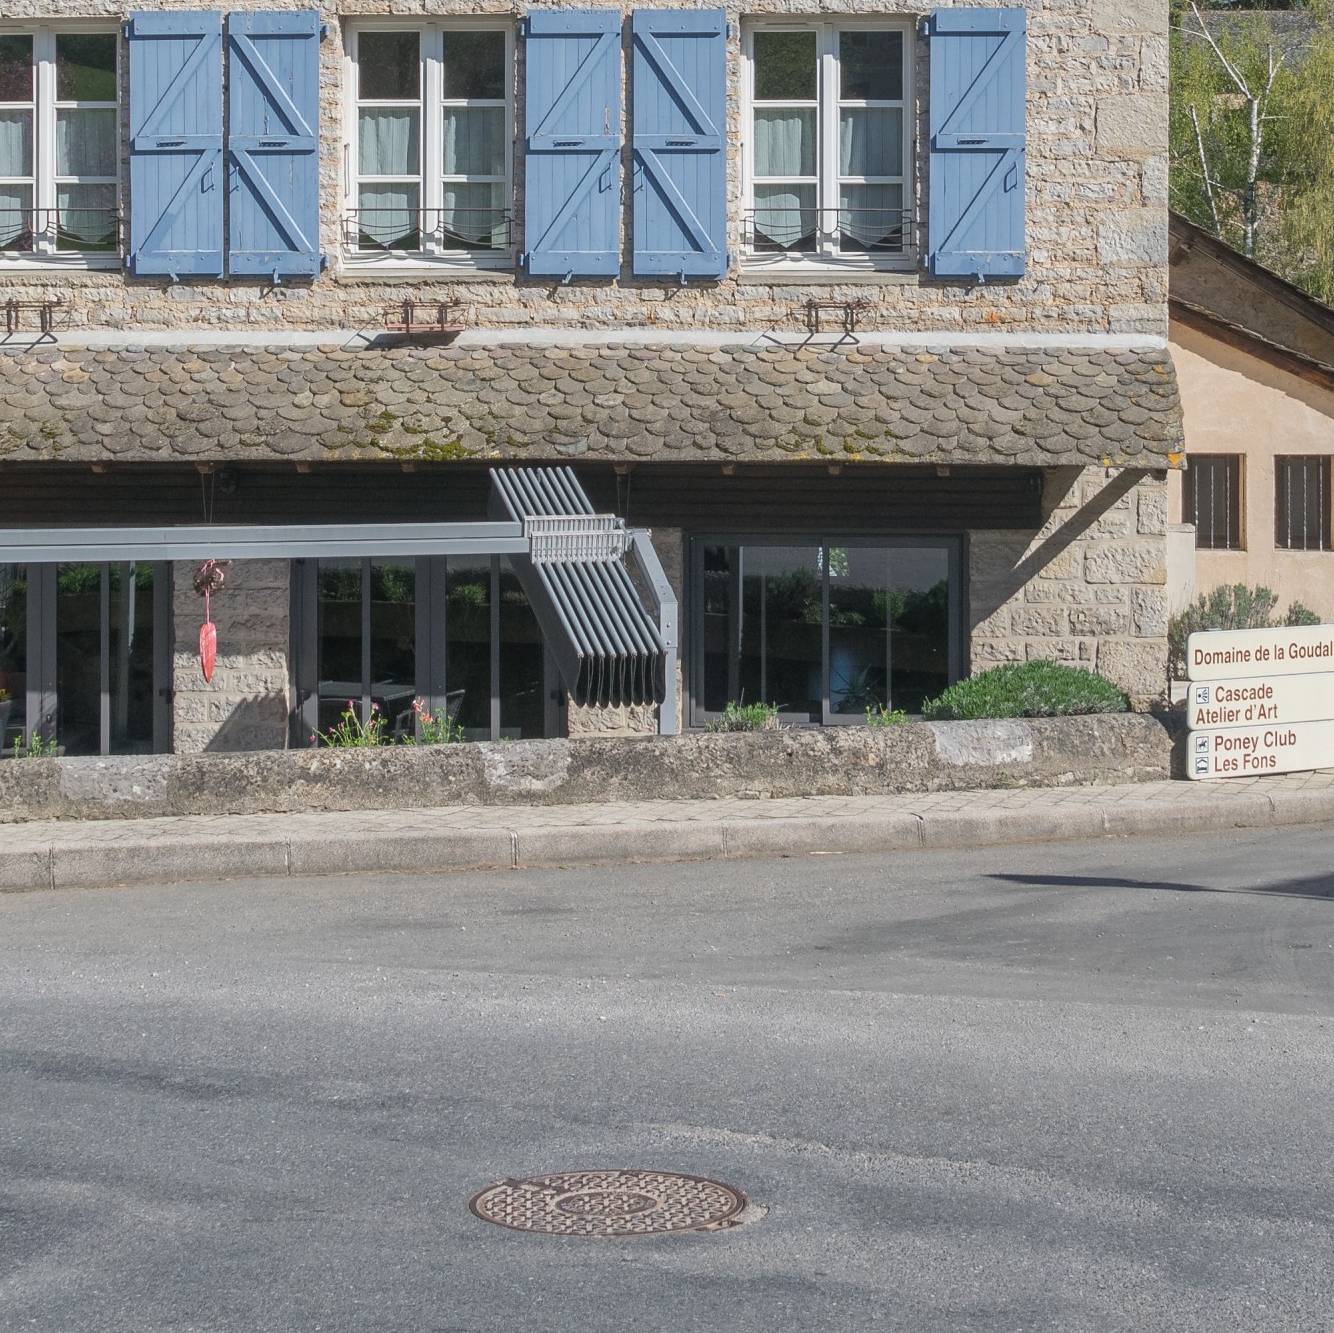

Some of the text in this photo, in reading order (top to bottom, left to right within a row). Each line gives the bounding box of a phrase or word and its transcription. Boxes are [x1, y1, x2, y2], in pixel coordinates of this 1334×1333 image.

[1194, 647, 1251, 665] Domaine
[1255, 645, 1270, 661] de
[1275, 644, 1285, 660] la
[1215, 683, 1273, 703] Cascade
[1196, 704, 1278, 725] Atelier d'Art
[1214, 730, 1297, 753] Poney Club
[1214, 752, 1276, 772] Les Fons
